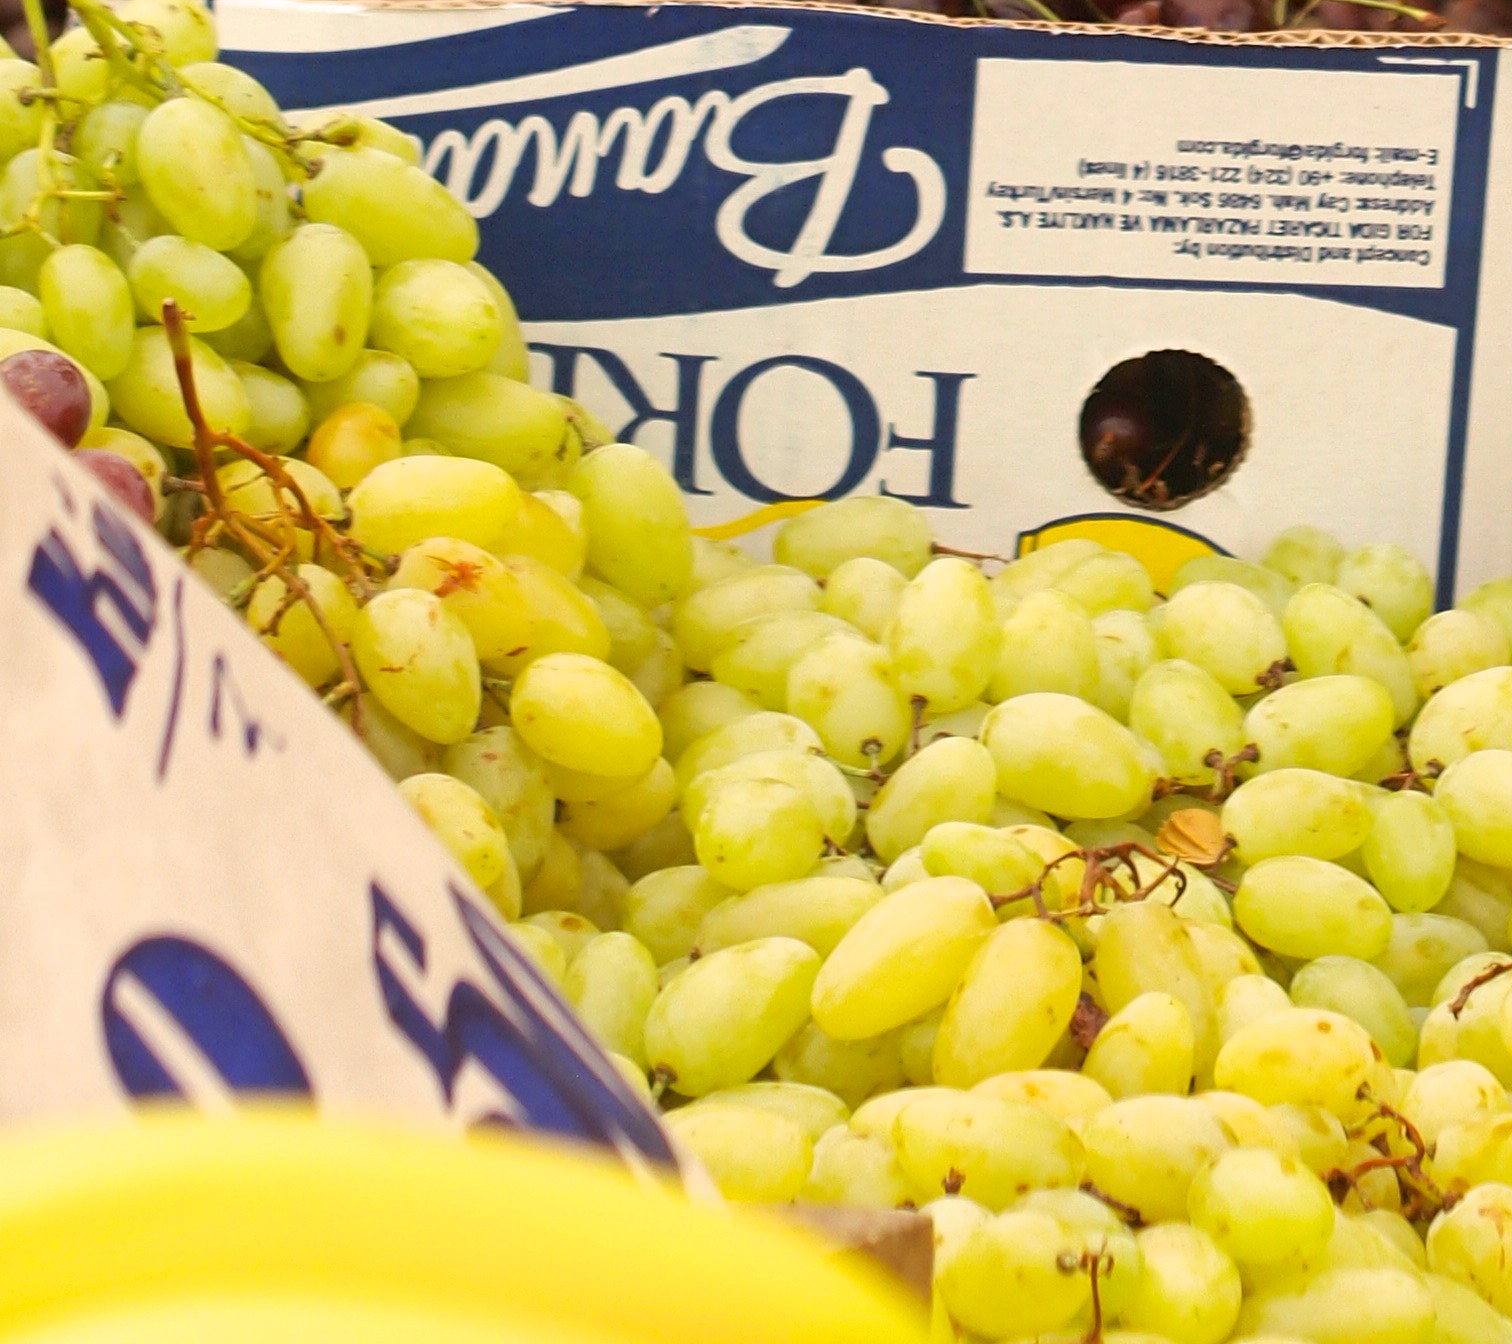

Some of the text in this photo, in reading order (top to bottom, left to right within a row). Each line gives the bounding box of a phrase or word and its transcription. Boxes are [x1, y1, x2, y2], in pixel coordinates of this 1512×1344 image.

[1374, 148, 1439, 166] E-mail:
[1078, 158, 1127, 179] lines)
[1132, 161, 1150, 181] (4
[1247, 165, 1292, 186] (324)
[1298, 170, 1334, 186] +90
[1338, 170, 1436, 190] Telephone:
[985, 182, 1116, 204] Mersin/Turkey
[1122, 190, 1133, 205] 4
[1355, 198, 1435, 216] Address:
[1120, 215, 1143, 232] VE
[1150, 216, 1261, 236] PAZARLAMA
[1349, 223, 1391, 239] GIDA
[1397, 225, 1433, 241] FOR
[1173, 239, 1431, 266] Concept and Distribution by:
